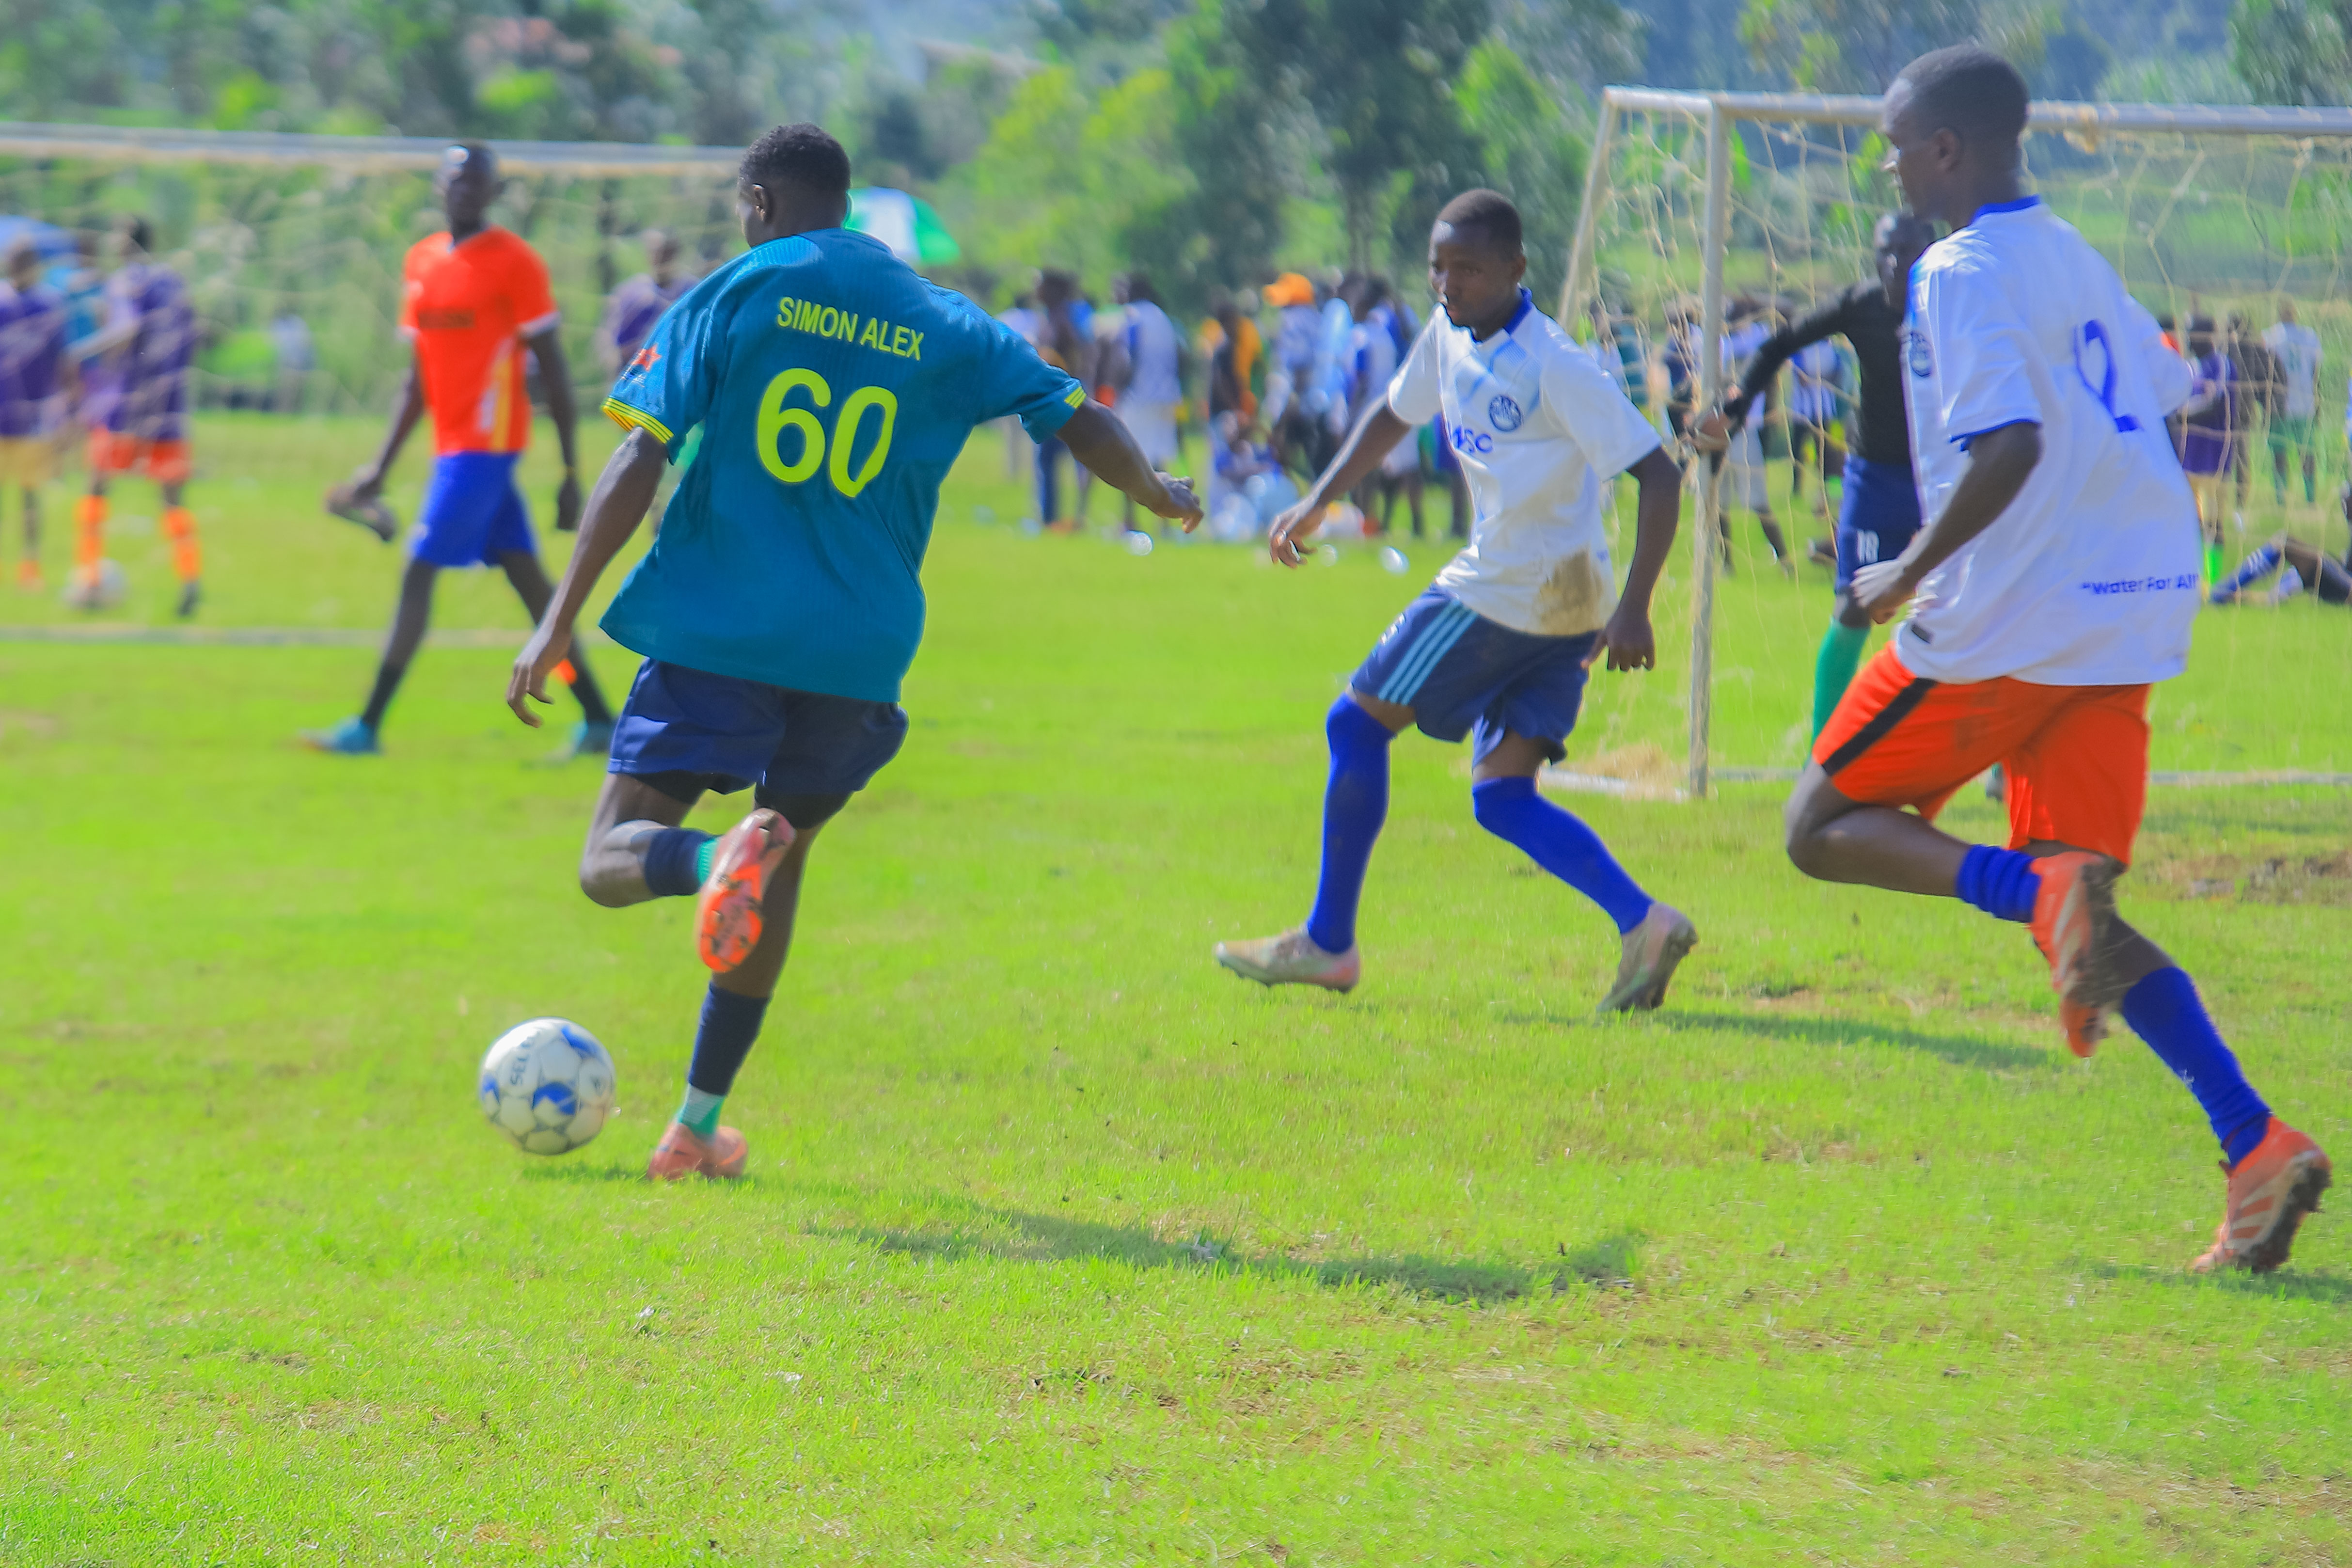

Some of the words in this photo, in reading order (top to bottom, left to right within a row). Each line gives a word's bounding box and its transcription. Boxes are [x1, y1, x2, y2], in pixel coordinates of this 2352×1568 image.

[777, 296, 858, 342] SIMON
[860, 317, 924, 361] ALEX
[757, 367, 898, 498] 60
